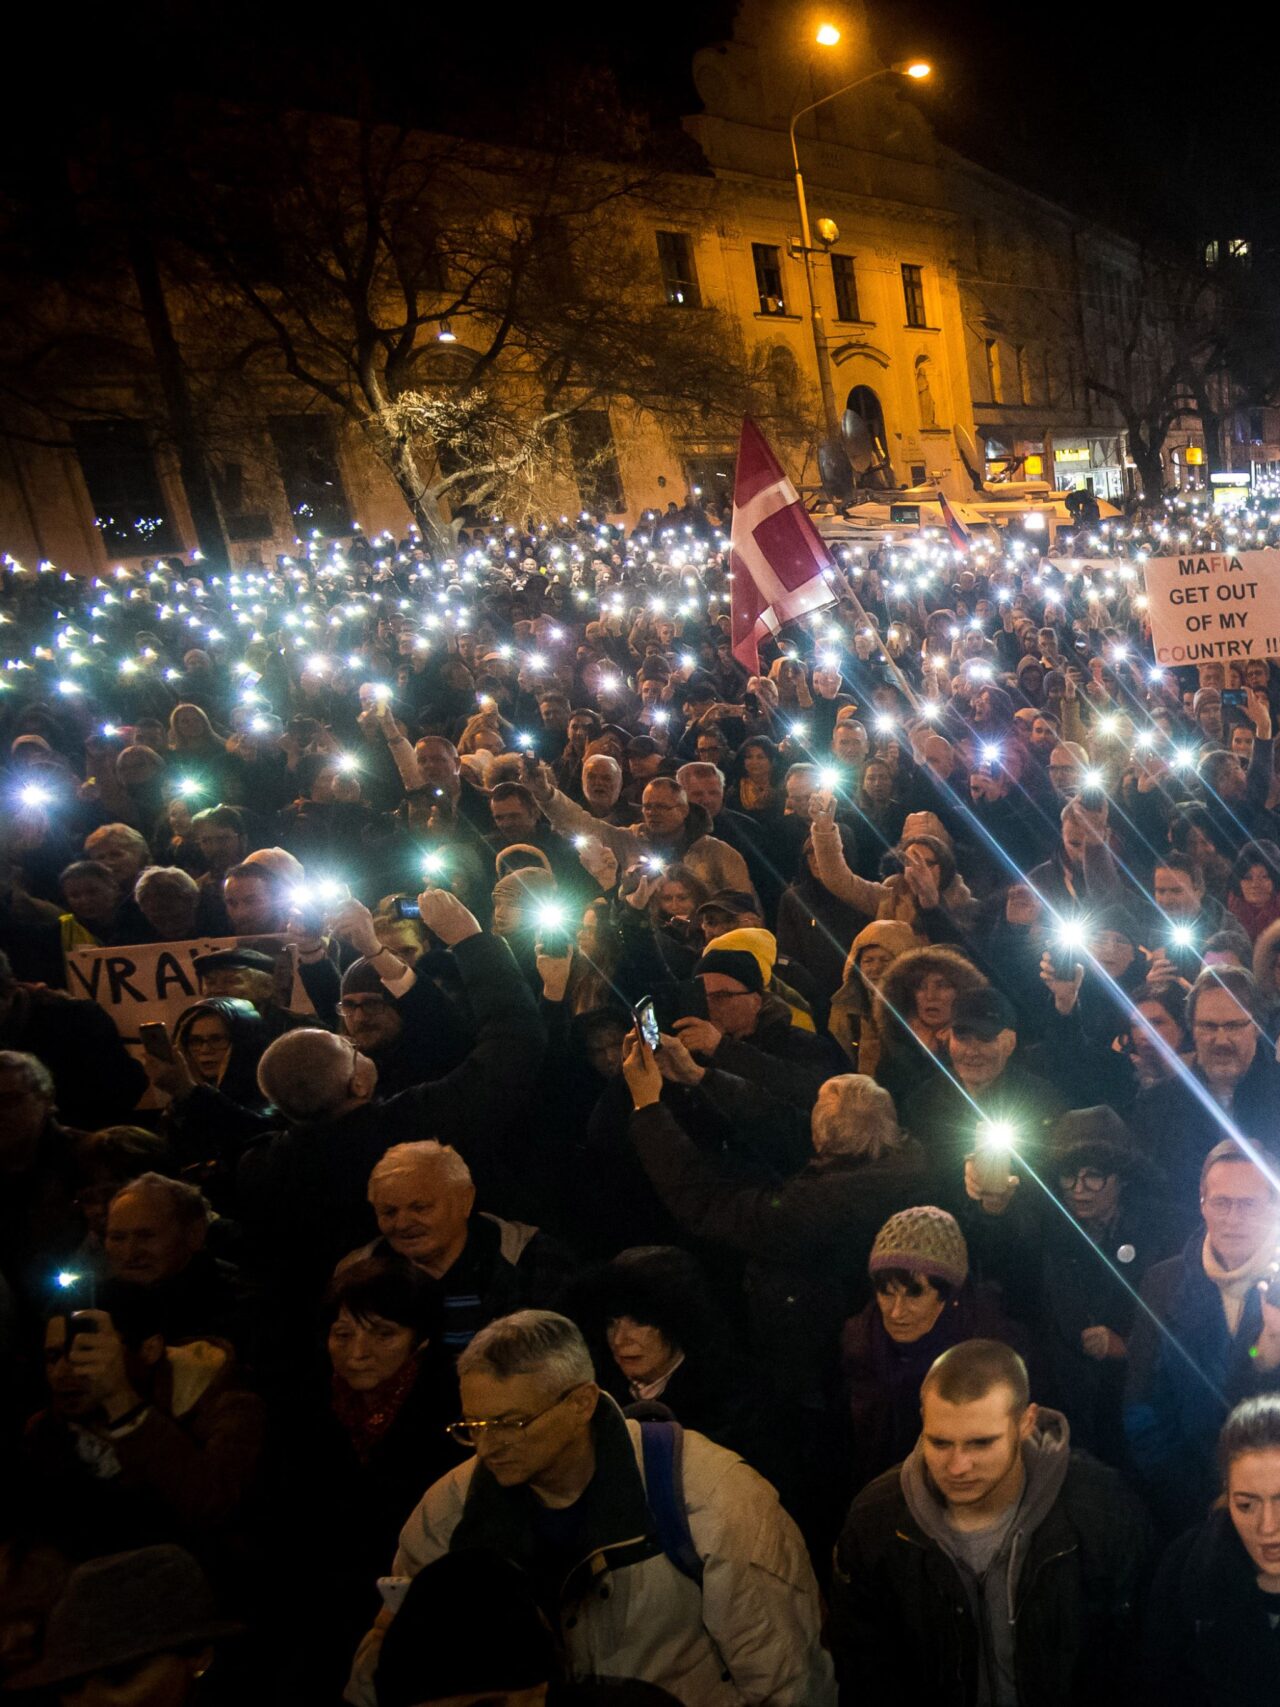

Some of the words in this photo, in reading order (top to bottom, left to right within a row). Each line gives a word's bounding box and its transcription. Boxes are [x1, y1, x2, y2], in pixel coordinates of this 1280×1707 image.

[1178, 556, 1243, 576] MAFIA
[1169, 586, 1210, 605] GET
[1216, 582, 1258, 601] OUT
[1185, 614, 1212, 632] OF
[1219, 612, 1249, 629] MY
[1157, 639, 1253, 664] COUNTRY
